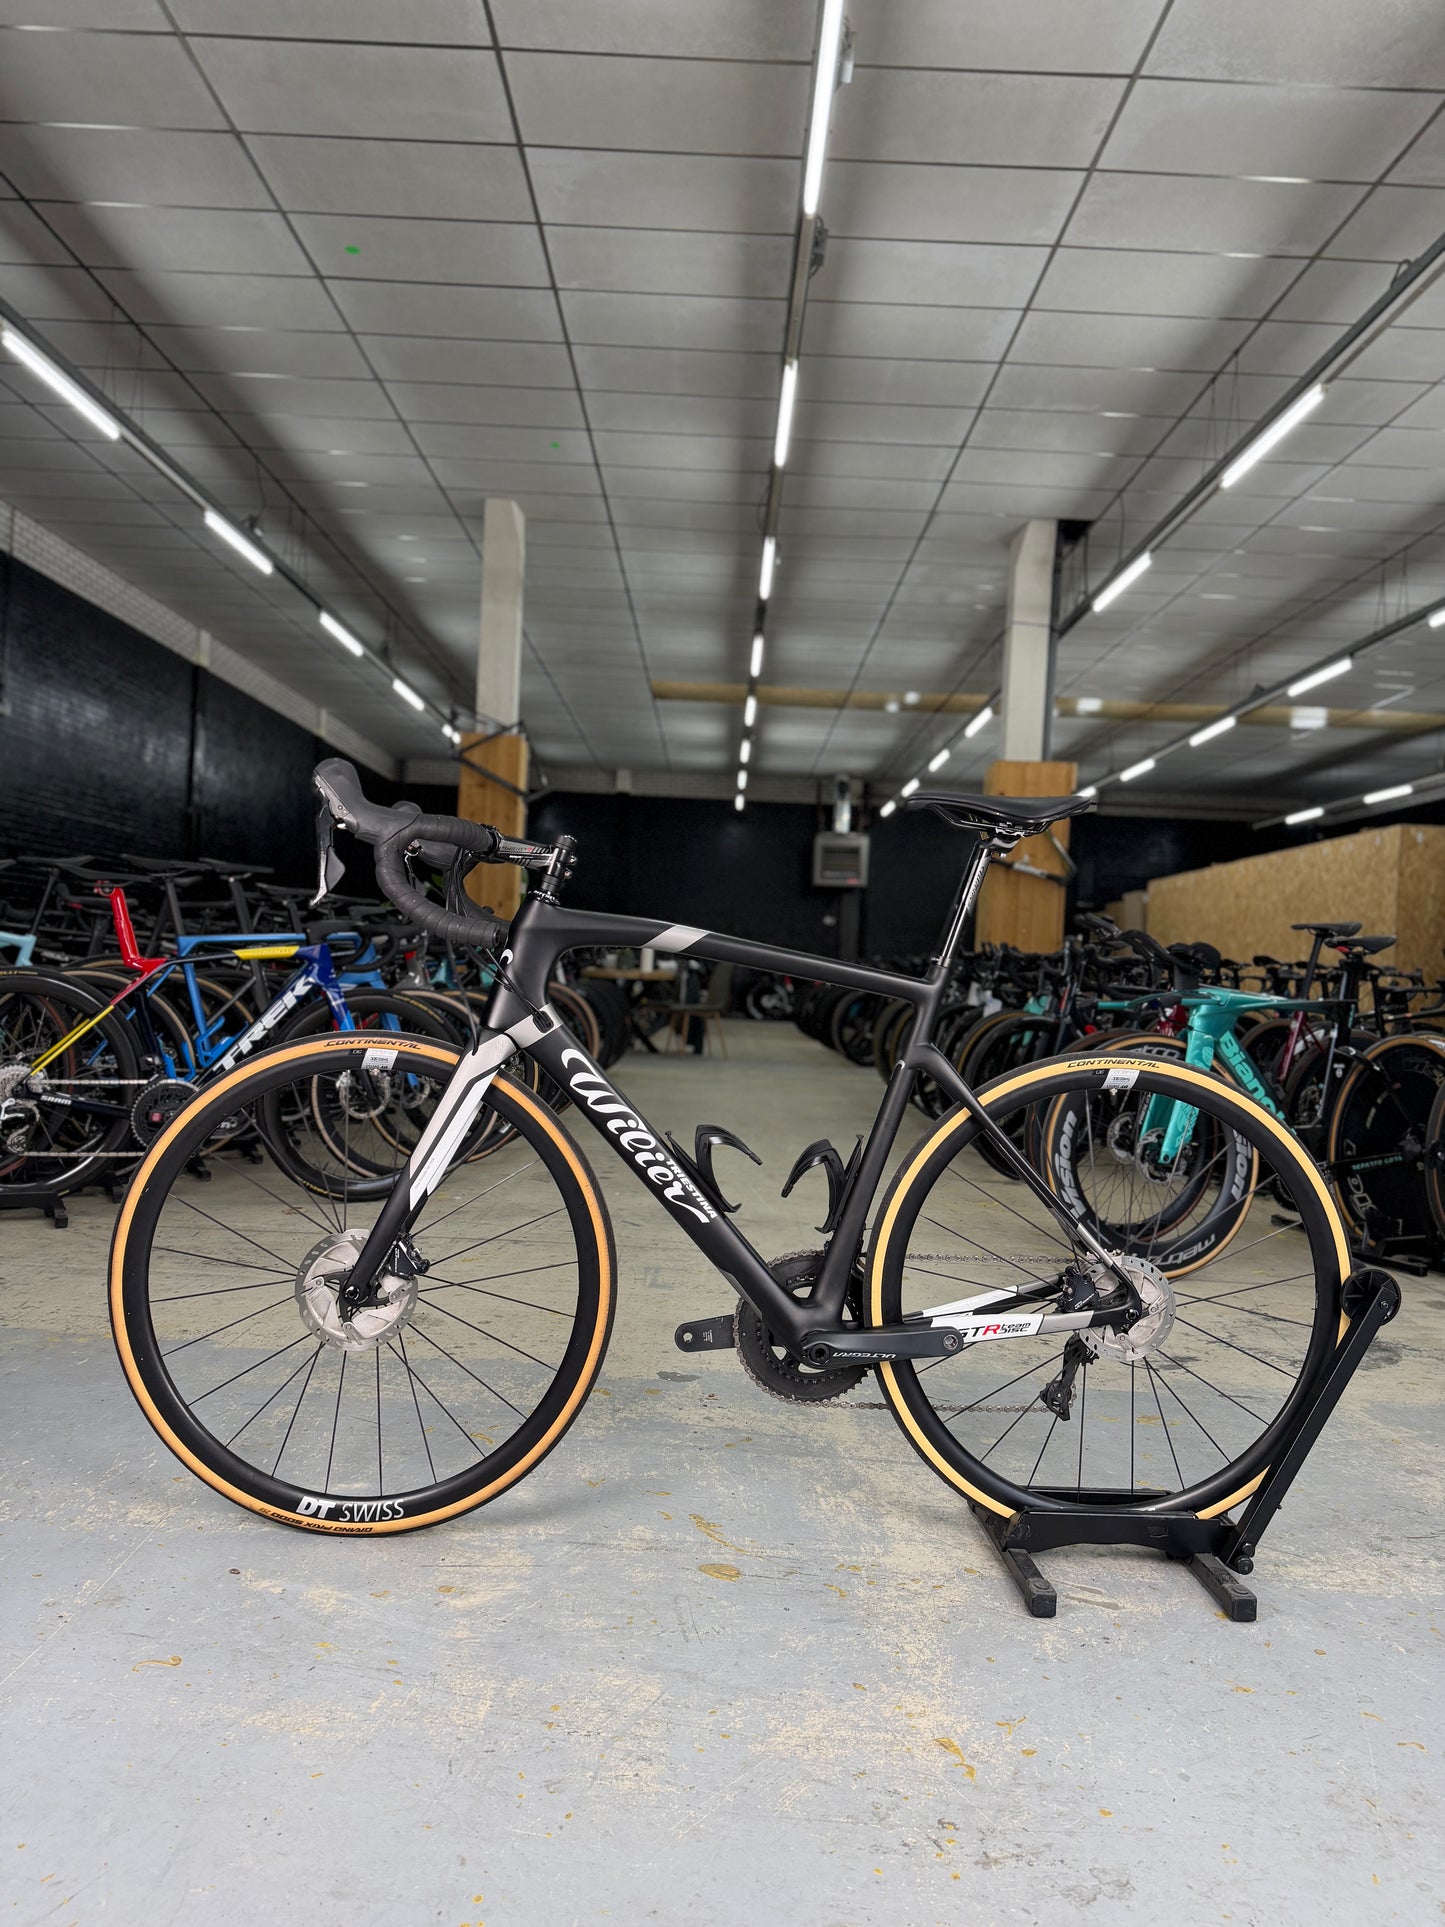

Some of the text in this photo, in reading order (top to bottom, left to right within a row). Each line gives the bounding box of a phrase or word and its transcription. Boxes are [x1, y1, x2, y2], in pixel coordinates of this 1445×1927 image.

[212, 974, 316, 1072] TREK
[324, 1038, 421, 1050] CONTINENTAL
[1067, 1059, 1160, 1069] CONTINENTAL
[41, 1095, 72, 1106] SRAM
[561, 1048, 710, 1223] Wilier
[666, 1158, 718, 1219] TRIESTINA
[832, 1351, 897, 1359] ULTEGRA
[295, 1495, 405, 1522] DT SWISS
[306, 1521, 333, 1531] PRIX
